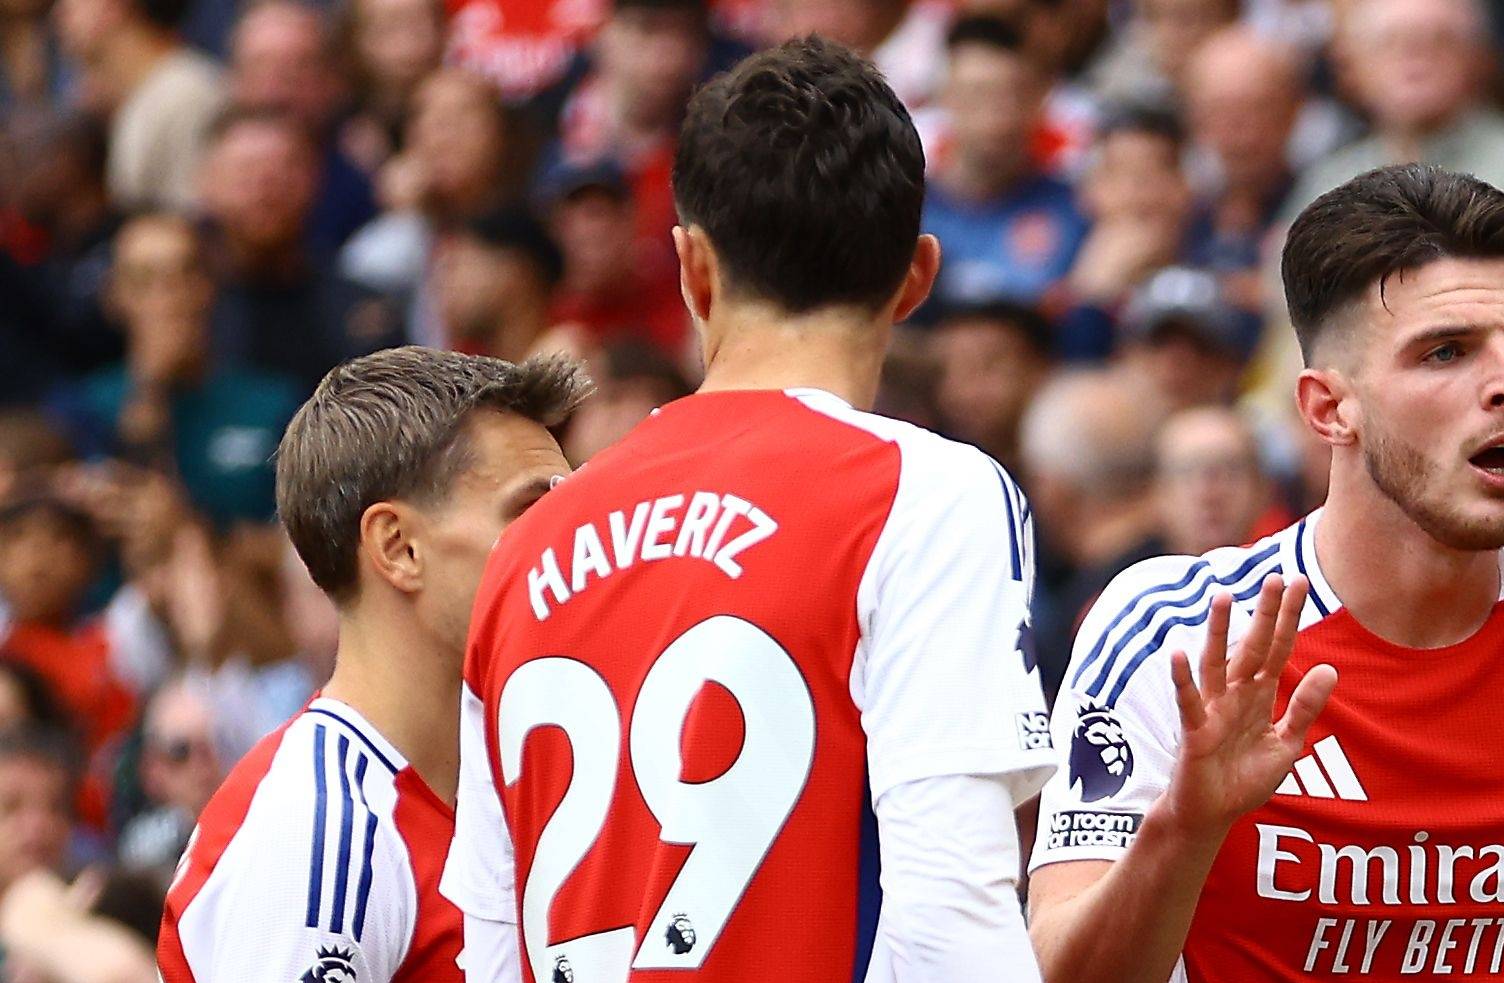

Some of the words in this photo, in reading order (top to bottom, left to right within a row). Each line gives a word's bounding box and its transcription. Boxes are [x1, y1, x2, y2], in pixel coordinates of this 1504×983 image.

[527, 491, 779, 622] HAVERTZ
[1072, 813, 1133, 834] room
[1303, 917, 1392, 974] FLY
